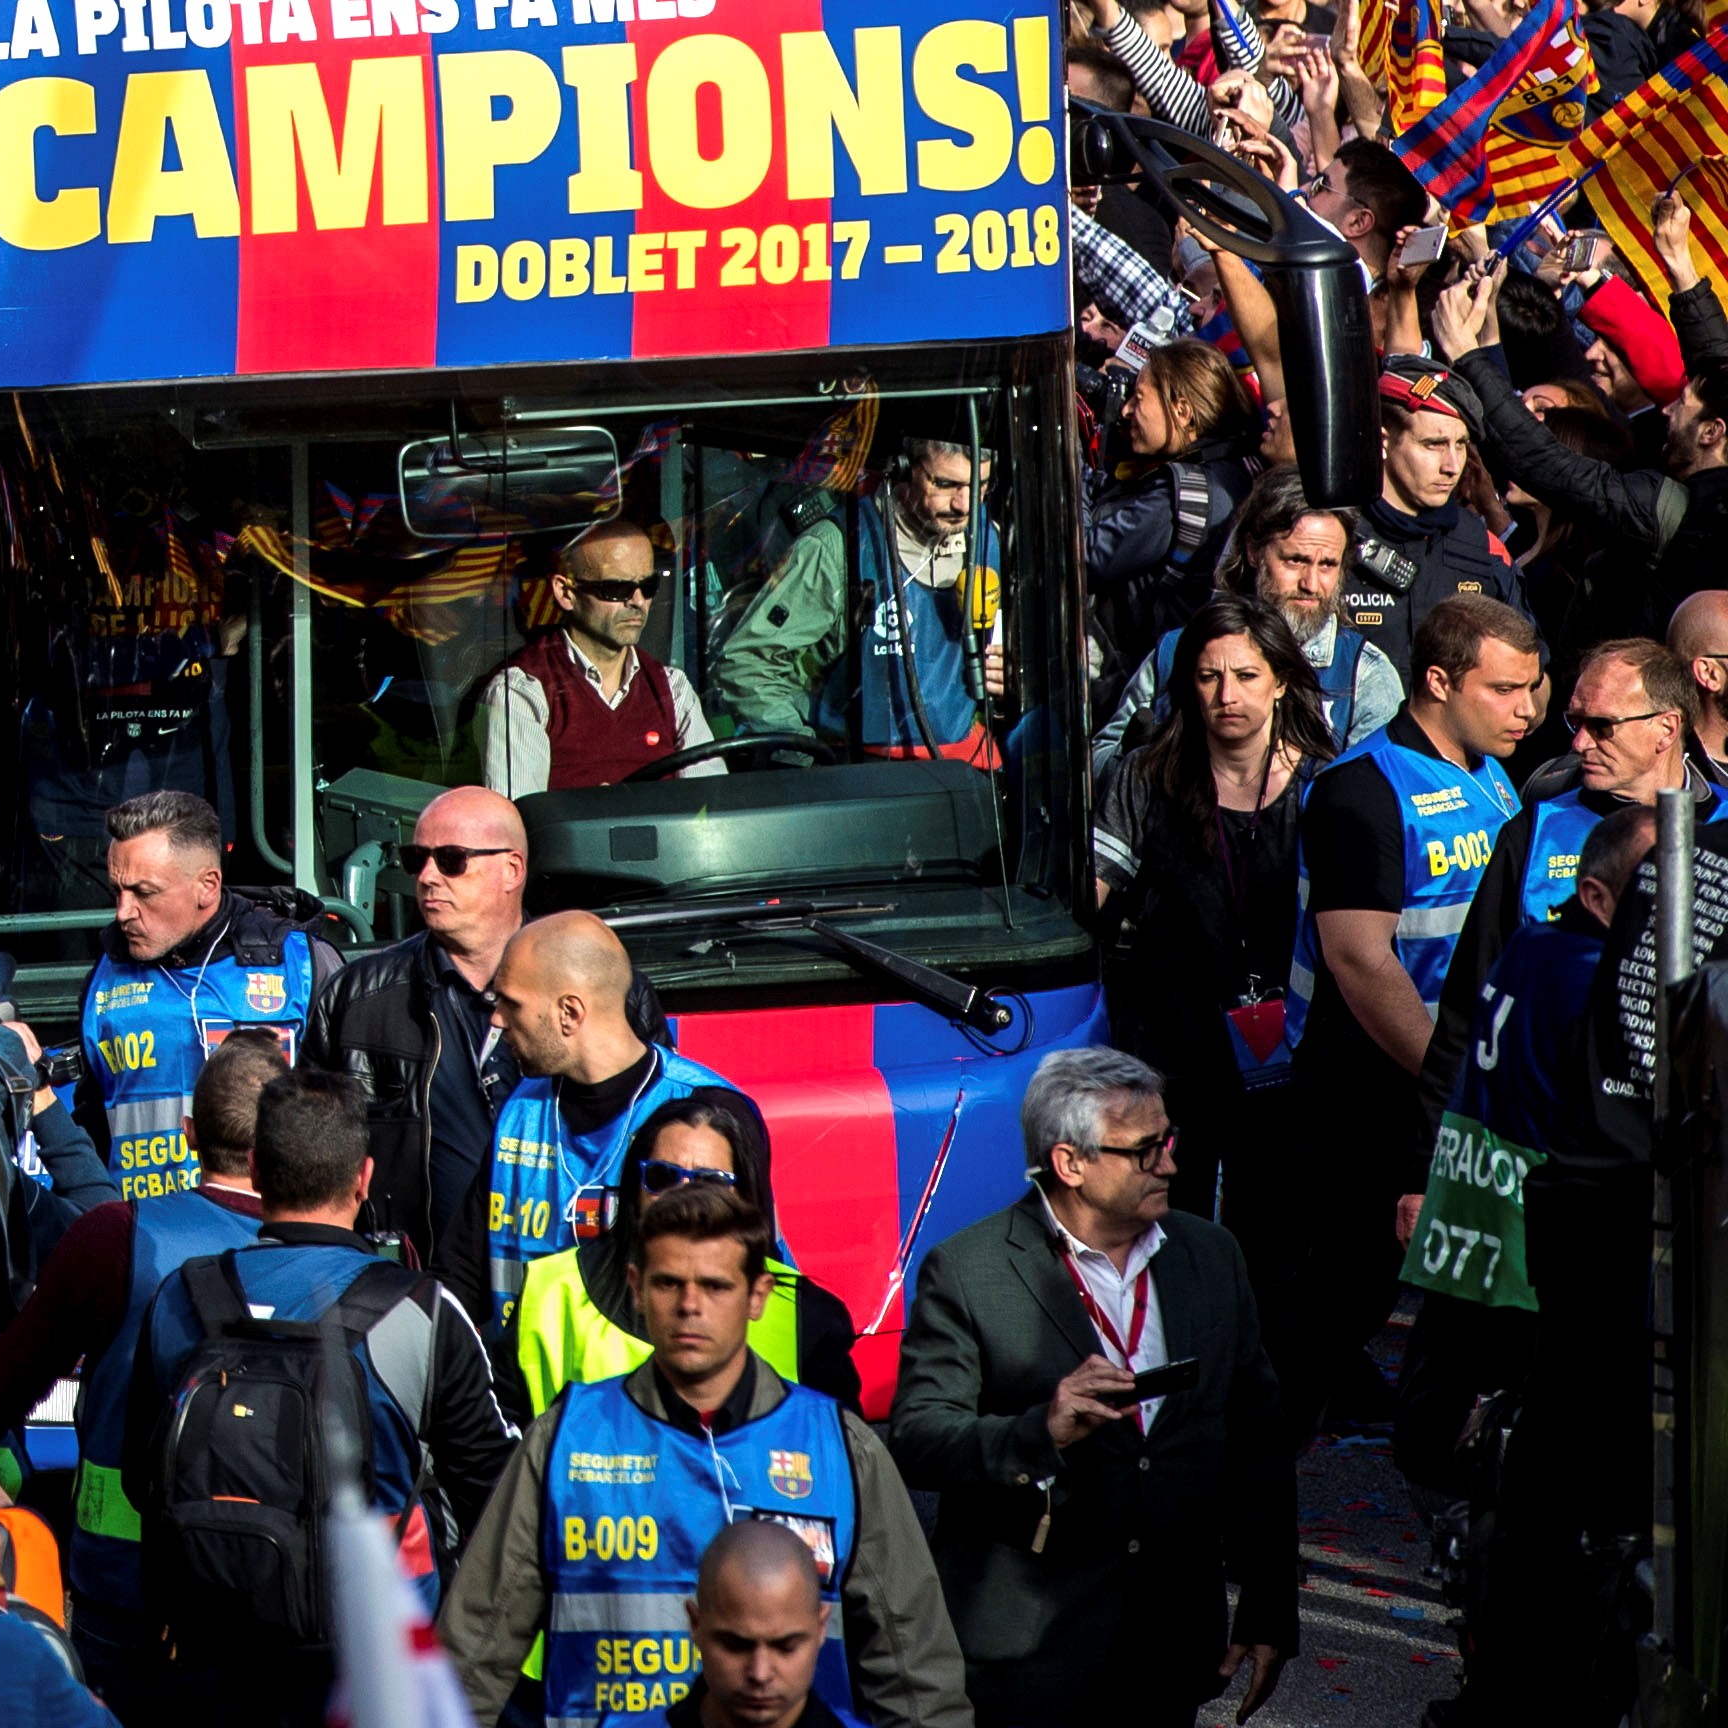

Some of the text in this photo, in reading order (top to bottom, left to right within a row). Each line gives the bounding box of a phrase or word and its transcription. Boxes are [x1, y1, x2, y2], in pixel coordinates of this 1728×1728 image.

[453, 228, 710, 307] DOBLET
[717, 219, 871, 288] 2017
[936, 205, 1061, 275] 2018
[1426, 829, 1492, 878] B-003
[120, 1133, 199, 1170] SEGU
[121, 1167, 202, 1202] FCBARC
[488, 1191, 551, 1240] B-10
[569, 1451, 659, 1471] SEGURETAT
[564, 1515, 660, 1562] B-009
